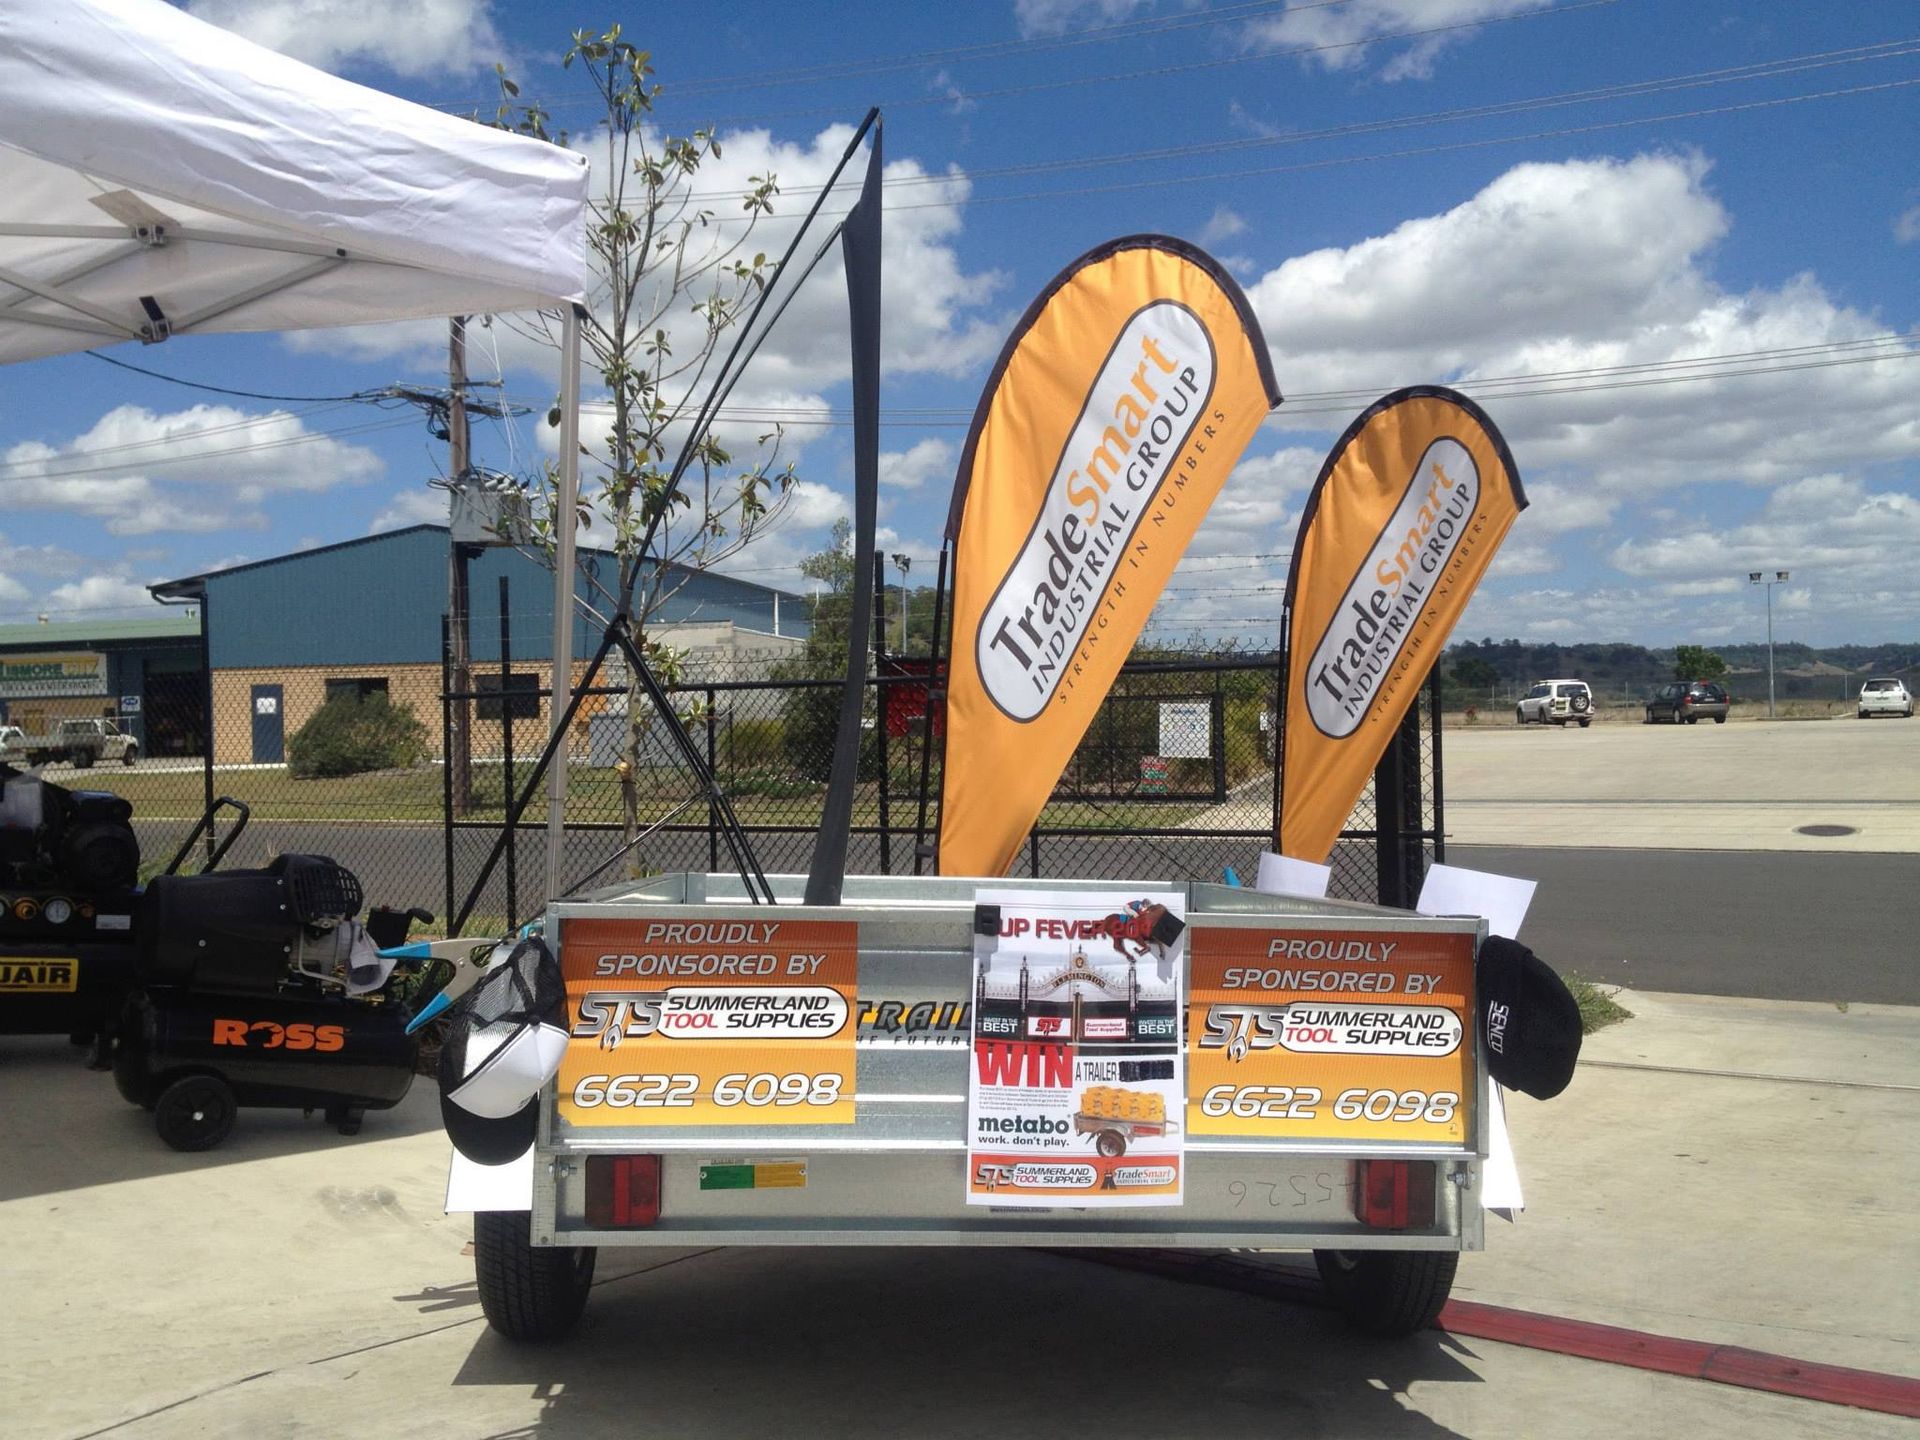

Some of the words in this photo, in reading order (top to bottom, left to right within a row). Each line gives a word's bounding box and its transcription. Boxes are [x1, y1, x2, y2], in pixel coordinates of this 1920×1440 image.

[990, 334, 1178, 671] TradeSmart
[1033, 502, 1130, 694] INDUSTRIAL
[1126, 365, 1200, 491] GROUP
[1059, 582, 1126, 704] STRENGTH
[1130, 542, 1148, 569] IN
[1153, 409, 1226, 526] NUMBERS
[1314, 462, 1455, 703] TradeSmart
[1344, 581, 1426, 719] INDUSTRIAL
[1420, 482, 1471, 574] GROUP
[1372, 637, 1422, 723] STRENGTH
[1423, 608, 1438, 629] IN
[1439, 513, 1487, 597] NUMBERS
[644, 923, 780, 944] PROUDLY
[999, 917, 1030, 938] UP
[1267, 938, 1398, 962] PROUDLY
[595, 954, 777, 976] SPONSORED
[786, 954, 827, 976] BY
[1222, 968, 1396, 994] SPONSORED
[1403, 972, 1442, 996] BY
[667, 996, 830, 1011] SUMMERLAND
[572, 991, 668, 1046] STS
[663, 1013, 718, 1029] TOOL
[726, 1013, 835, 1029] SUPPLIES
[983, 1022, 1018, 1033] BEST
[1139, 1024, 1174, 1035] BEST
[1199, 1003, 1290, 1058] STS
[1289, 1010, 1445, 1030] SUMMERLAND
[1490, 1001, 1510, 1054] SENCO
[212, 1019, 345, 1052] ROSS
[1285, 1027, 1337, 1044] TOOL
[1345, 1029, 1450, 1047] SUPPLIES
[975, 1041, 1073, 1088] WIN
[1075, 1061, 1082, 1081] A
[573, 1073, 700, 1108] 6622
[712, 1073, 843, 1107] 6098
[1201, 1084, 1322, 1119] 6622
[1332, 1088, 1460, 1124] 6098
[978, 1115, 1069, 1134] metabo
[978, 1135, 1010, 1144] work.
[1012, 1136, 1040, 1146] don't
[1044, 1138, 1070, 1148] play.
[974, 1163, 1016, 1187] STS
[1015, 1175, 1039, 1184] TOOL
[1043, 1175, 1092, 1184] SUPPLIES
[1016, 1166, 1089, 1176] SUMMERLAND
[1116, 1169, 1171, 1179] TradeSmart
